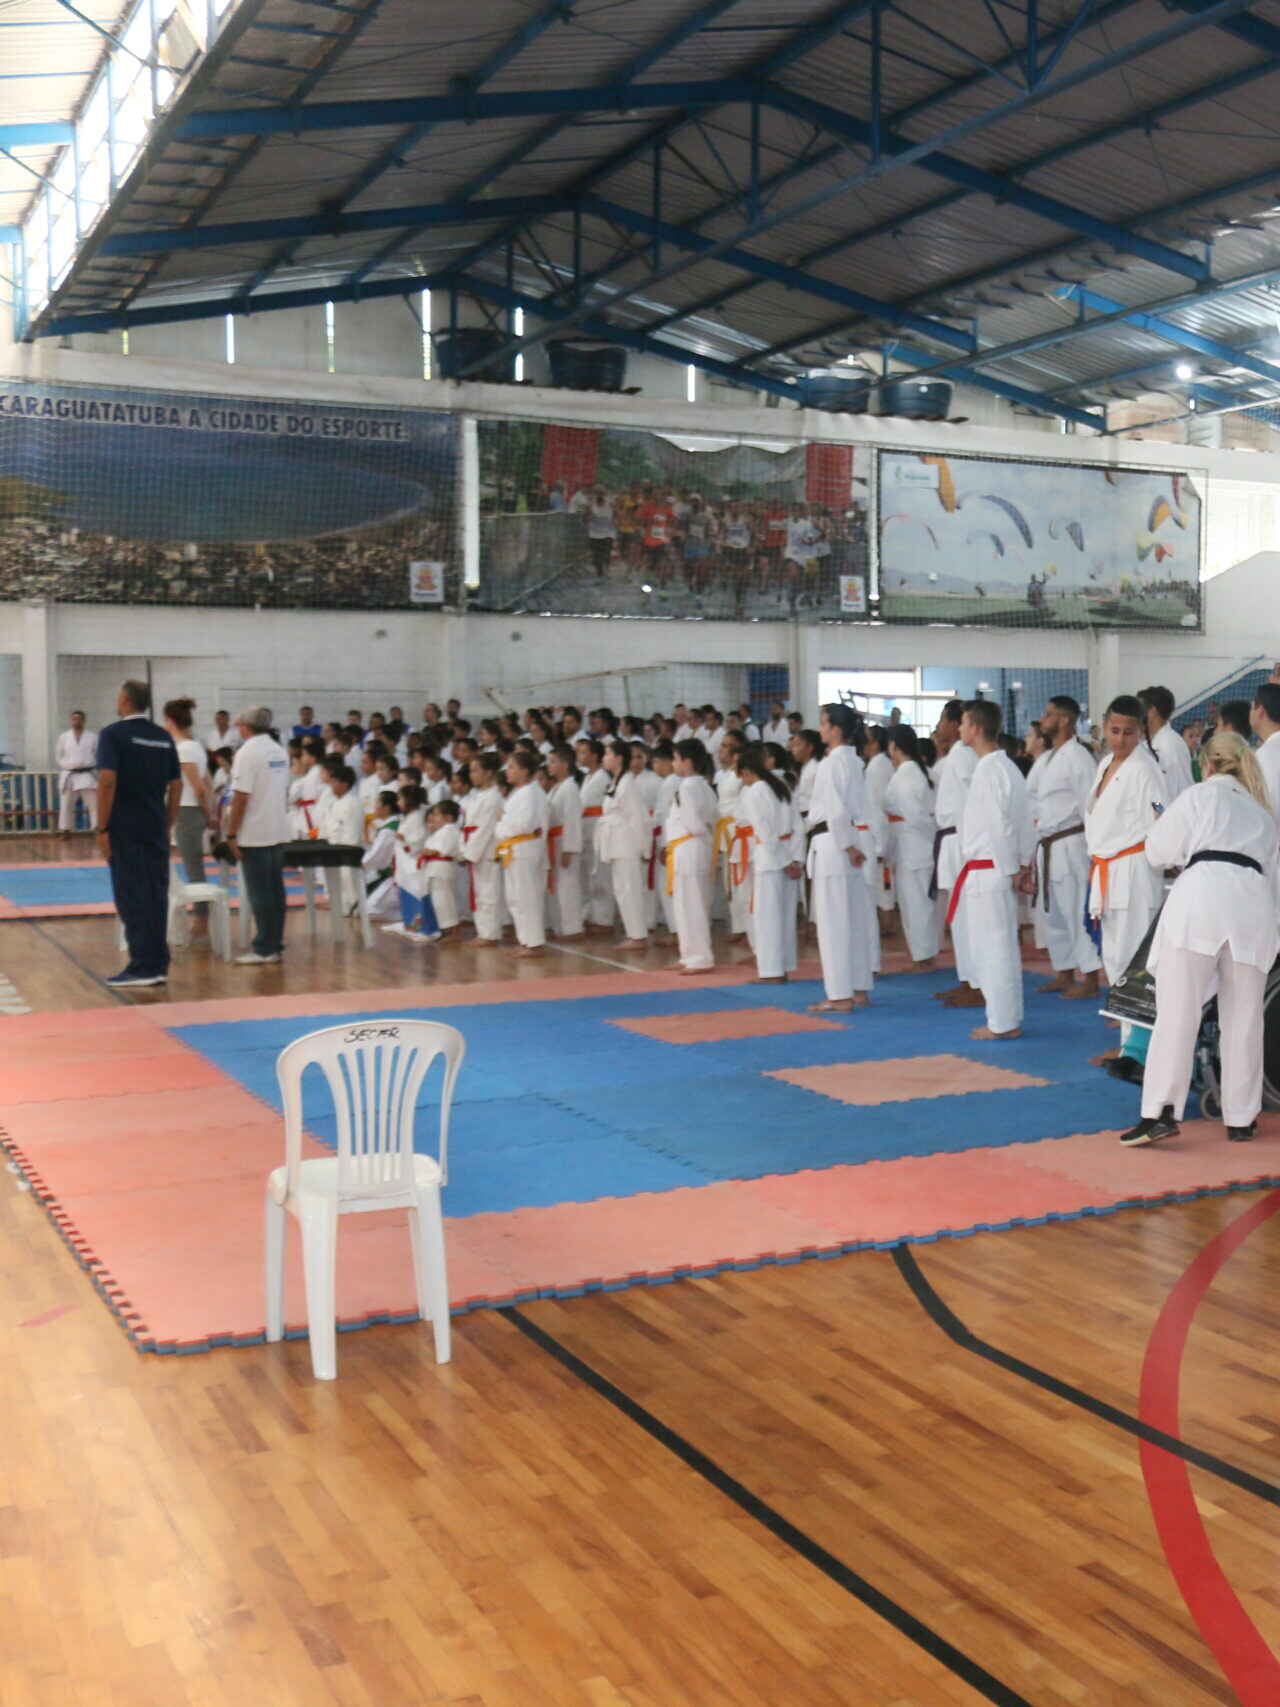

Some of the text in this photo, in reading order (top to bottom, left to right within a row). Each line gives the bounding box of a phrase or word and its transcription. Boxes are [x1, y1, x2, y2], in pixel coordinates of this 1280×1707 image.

[0, 395, 181, 426] CARAGUATATUBA
[188, 408, 201, 428] A
[208, 409, 280, 433] CIDADE
[286, 414, 314, 435] DO
